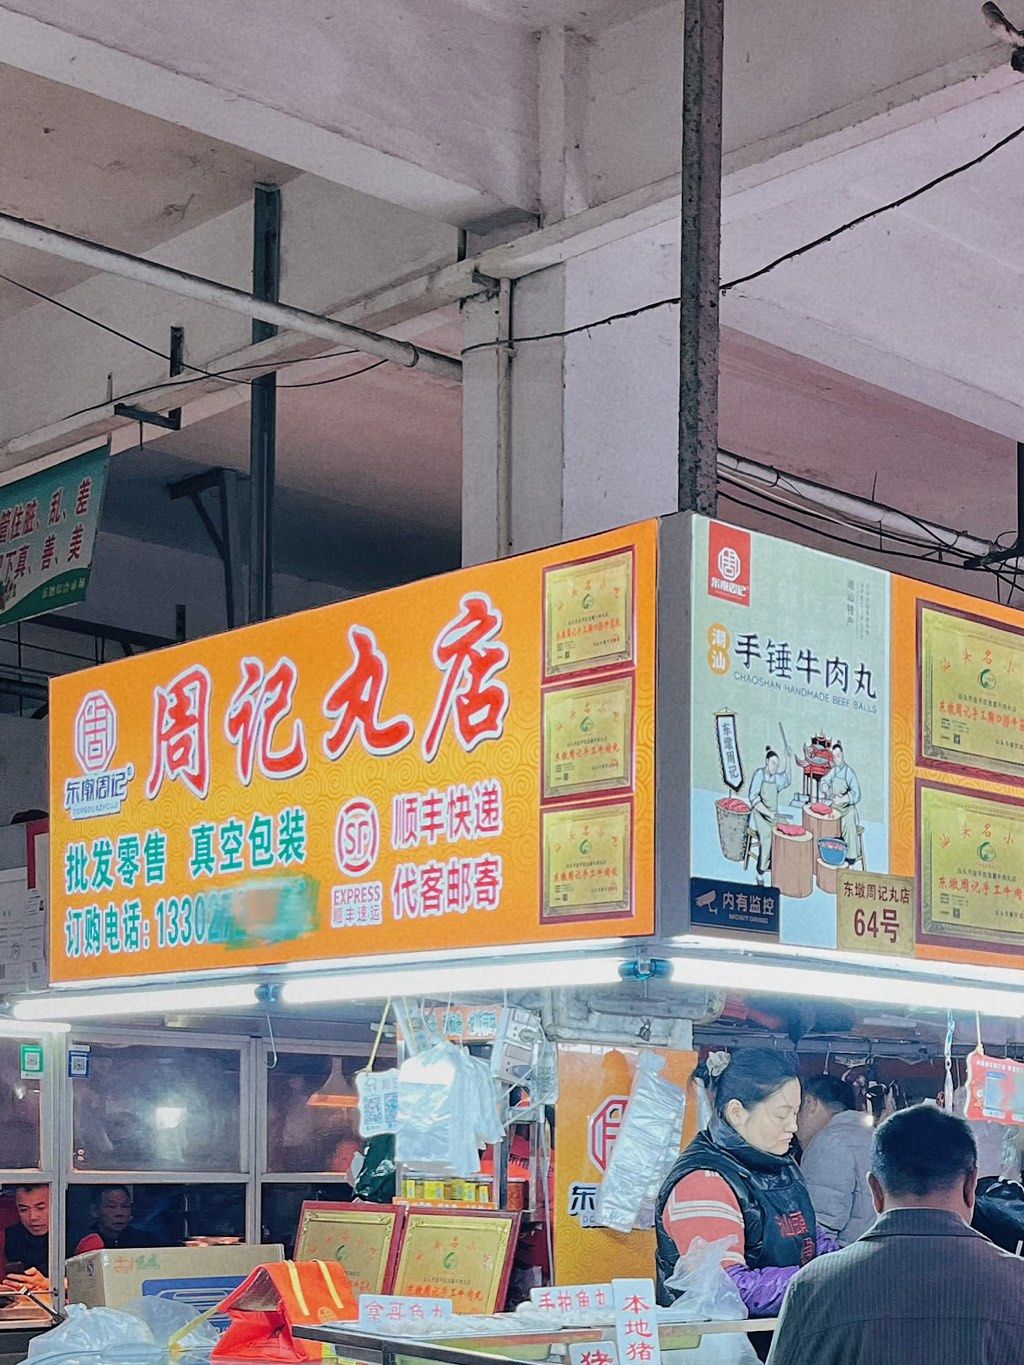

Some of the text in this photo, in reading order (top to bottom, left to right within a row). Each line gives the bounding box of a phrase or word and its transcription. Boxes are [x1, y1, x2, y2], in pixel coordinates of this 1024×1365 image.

[0, 524, 83, 582] 下真、善、美
[712, 628, 726, 670] 潮汕
[735, 633, 877, 699] 手锤牛肉丸
[148, 596, 507, 798] 周记丸店
[734, 671, 877, 713] CHAOSHAN HANDMADE BEEF BALLS
[66, 772, 125, 804] 东墩周记
[394, 783, 500, 847] 顺丰快递
[66, 809, 307, 893] 批发零售 真空包装
[334, 885, 381, 906] EXPRESS
[394, 857, 500, 917] 代客邮寄
[722, 891, 774, 916] 内有监控
[843, 881, 911, 904] 东墩周记丸店
[334, 904, 380, 924] 顺丰速运
[729, 913, 768, 924] MONITORING
[854, 908, 900, 943] 64号
